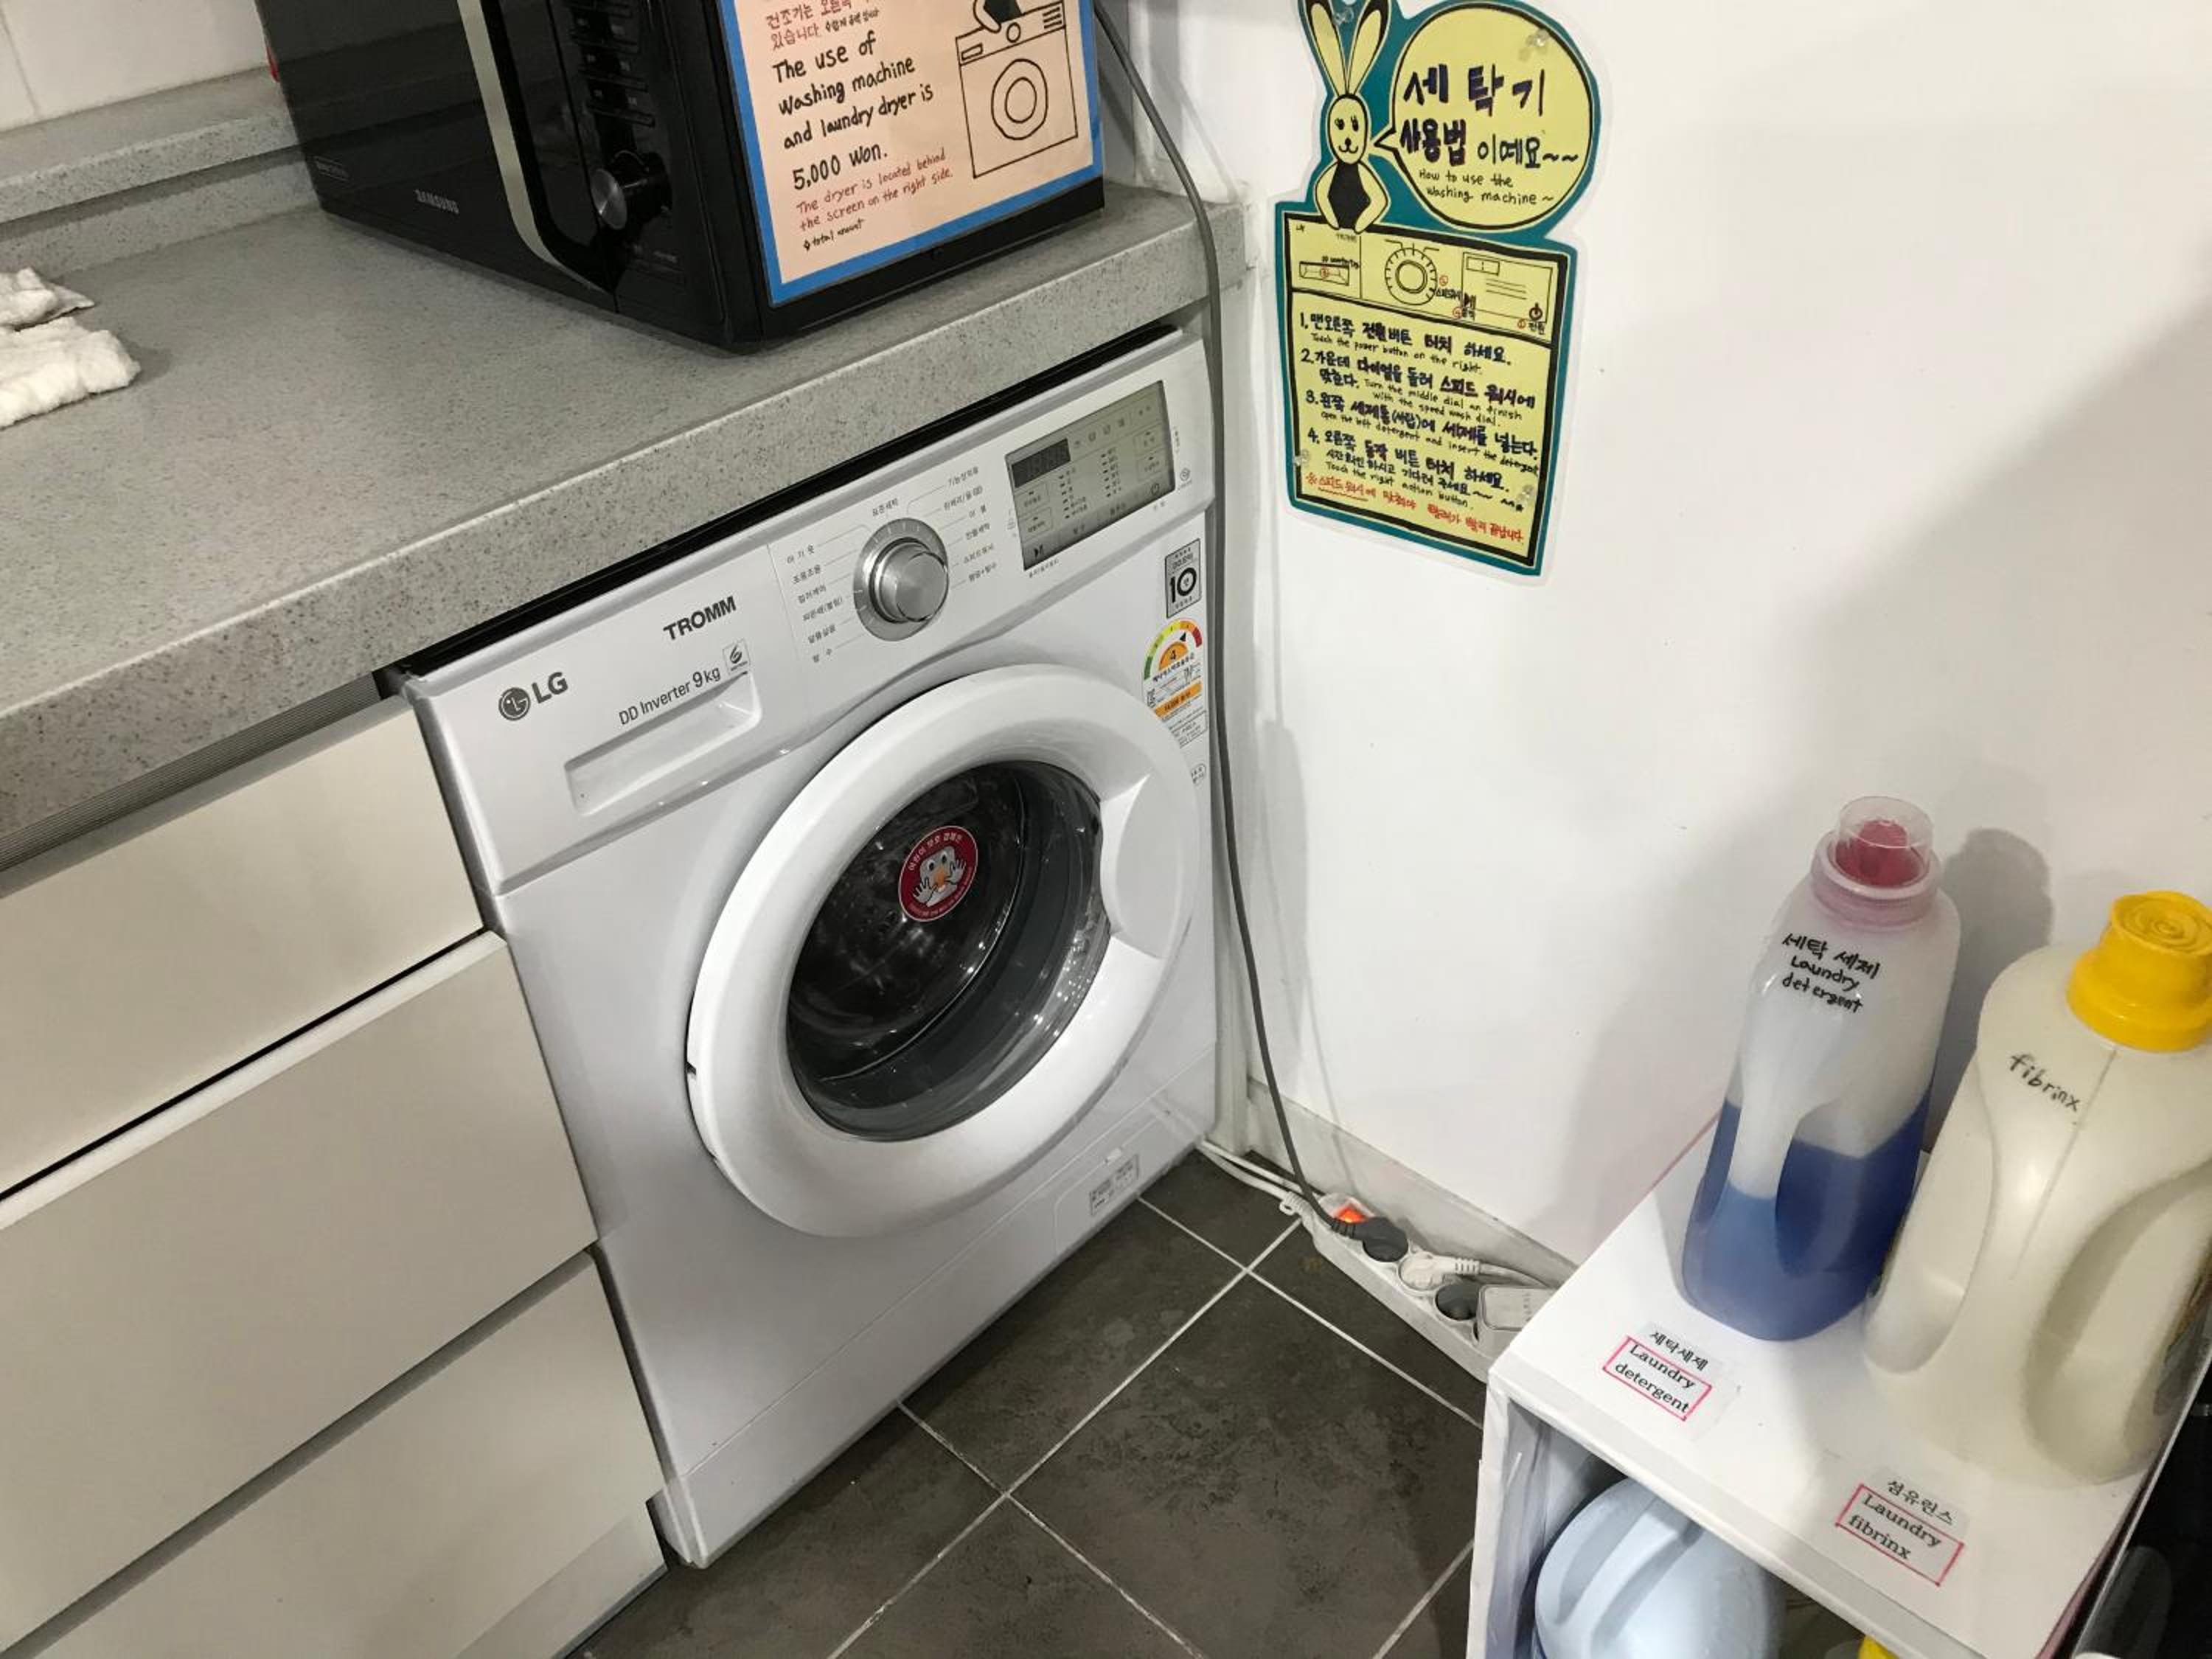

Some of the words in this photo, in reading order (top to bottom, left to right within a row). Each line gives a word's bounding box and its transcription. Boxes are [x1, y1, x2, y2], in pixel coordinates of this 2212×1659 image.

[766, 4, 813, 29] 건조기는
[771, 23, 820, 50] 있습니다
[772, 59, 807, 83] The
[815, 46, 849, 69] use
[858, 29, 876, 55] of
[852, 58, 915, 91] machine
[784, 120, 813, 149] and
[821, 105, 874, 137] laundry
[878, 91, 916, 115] dryer
[920, 83, 933, 102] is
[1399, 118, 1467, 166] 사용법
[793, 155, 841, 190] 5,000
[796, 199, 819, 214] The
[824, 183, 858, 203] dryer
[862, 179, 872, 189] is
[878, 161, 911, 185] located
[917, 147, 945, 170] behind
[1419, 170, 1440, 181] How
[1446, 171, 1457, 183] to
[1462, 174, 1484, 185] use
[1491, 173, 1514, 187] the
[414, 189, 459, 215] SAMSUNG
[800, 215, 821, 232] the
[827, 200, 865, 222] screen
[868, 195, 879, 206] on
[883, 189, 898, 201] the
[903, 176, 926, 195] right
[1481, 191, 1537, 206] machine
[1337, 337, 1350, 347] the
[1354, 341, 1380, 352] power
[1383, 347, 1408, 357] button
[1430, 355, 1447, 365] the
[1425, 334, 1452, 355] 터치
[1365, 378, 1383, 389] Turn
[1388, 385, 1402, 395] the
[1408, 390, 1438, 402] middle
[1444, 397, 1464, 408] dial
[1440, 375, 1478, 397] 스피드
[1399, 398, 1413, 407] the
[1419, 404, 1444, 415] speed
[1449, 410, 1471, 421] wash
[1395, 448, 1420, 467] 버튼
[1426, 437, 1442, 446] and
[1449, 441, 1481, 456] insert
[1484, 451, 1498, 461] the
[1326, 461, 1348, 473] Touch
[1353, 469, 1366, 479] the
[1370, 474, 1395, 487] right
[664, 595, 737, 641] TROMM
[531, 671, 568, 704] LG
[619, 709, 639, 726] DD
[640, 681, 692, 714] Inverter
[1782, 933, 1829, 961] 세탁
[1833, 951, 1880, 979] 세제
[2010, 1054, 2080, 1112] fibrinx
[1630, 1344, 1695, 1388] Laundry
[1650, 1331, 1708, 1371] 세탁세제
[1615, 1363, 1690, 1413] detergent
[1888, 1480, 1953, 1526] 섬유린스
[1848, 1514, 1911, 1559] fibrinx
[1863, 1494, 1941, 1548] Laundry
